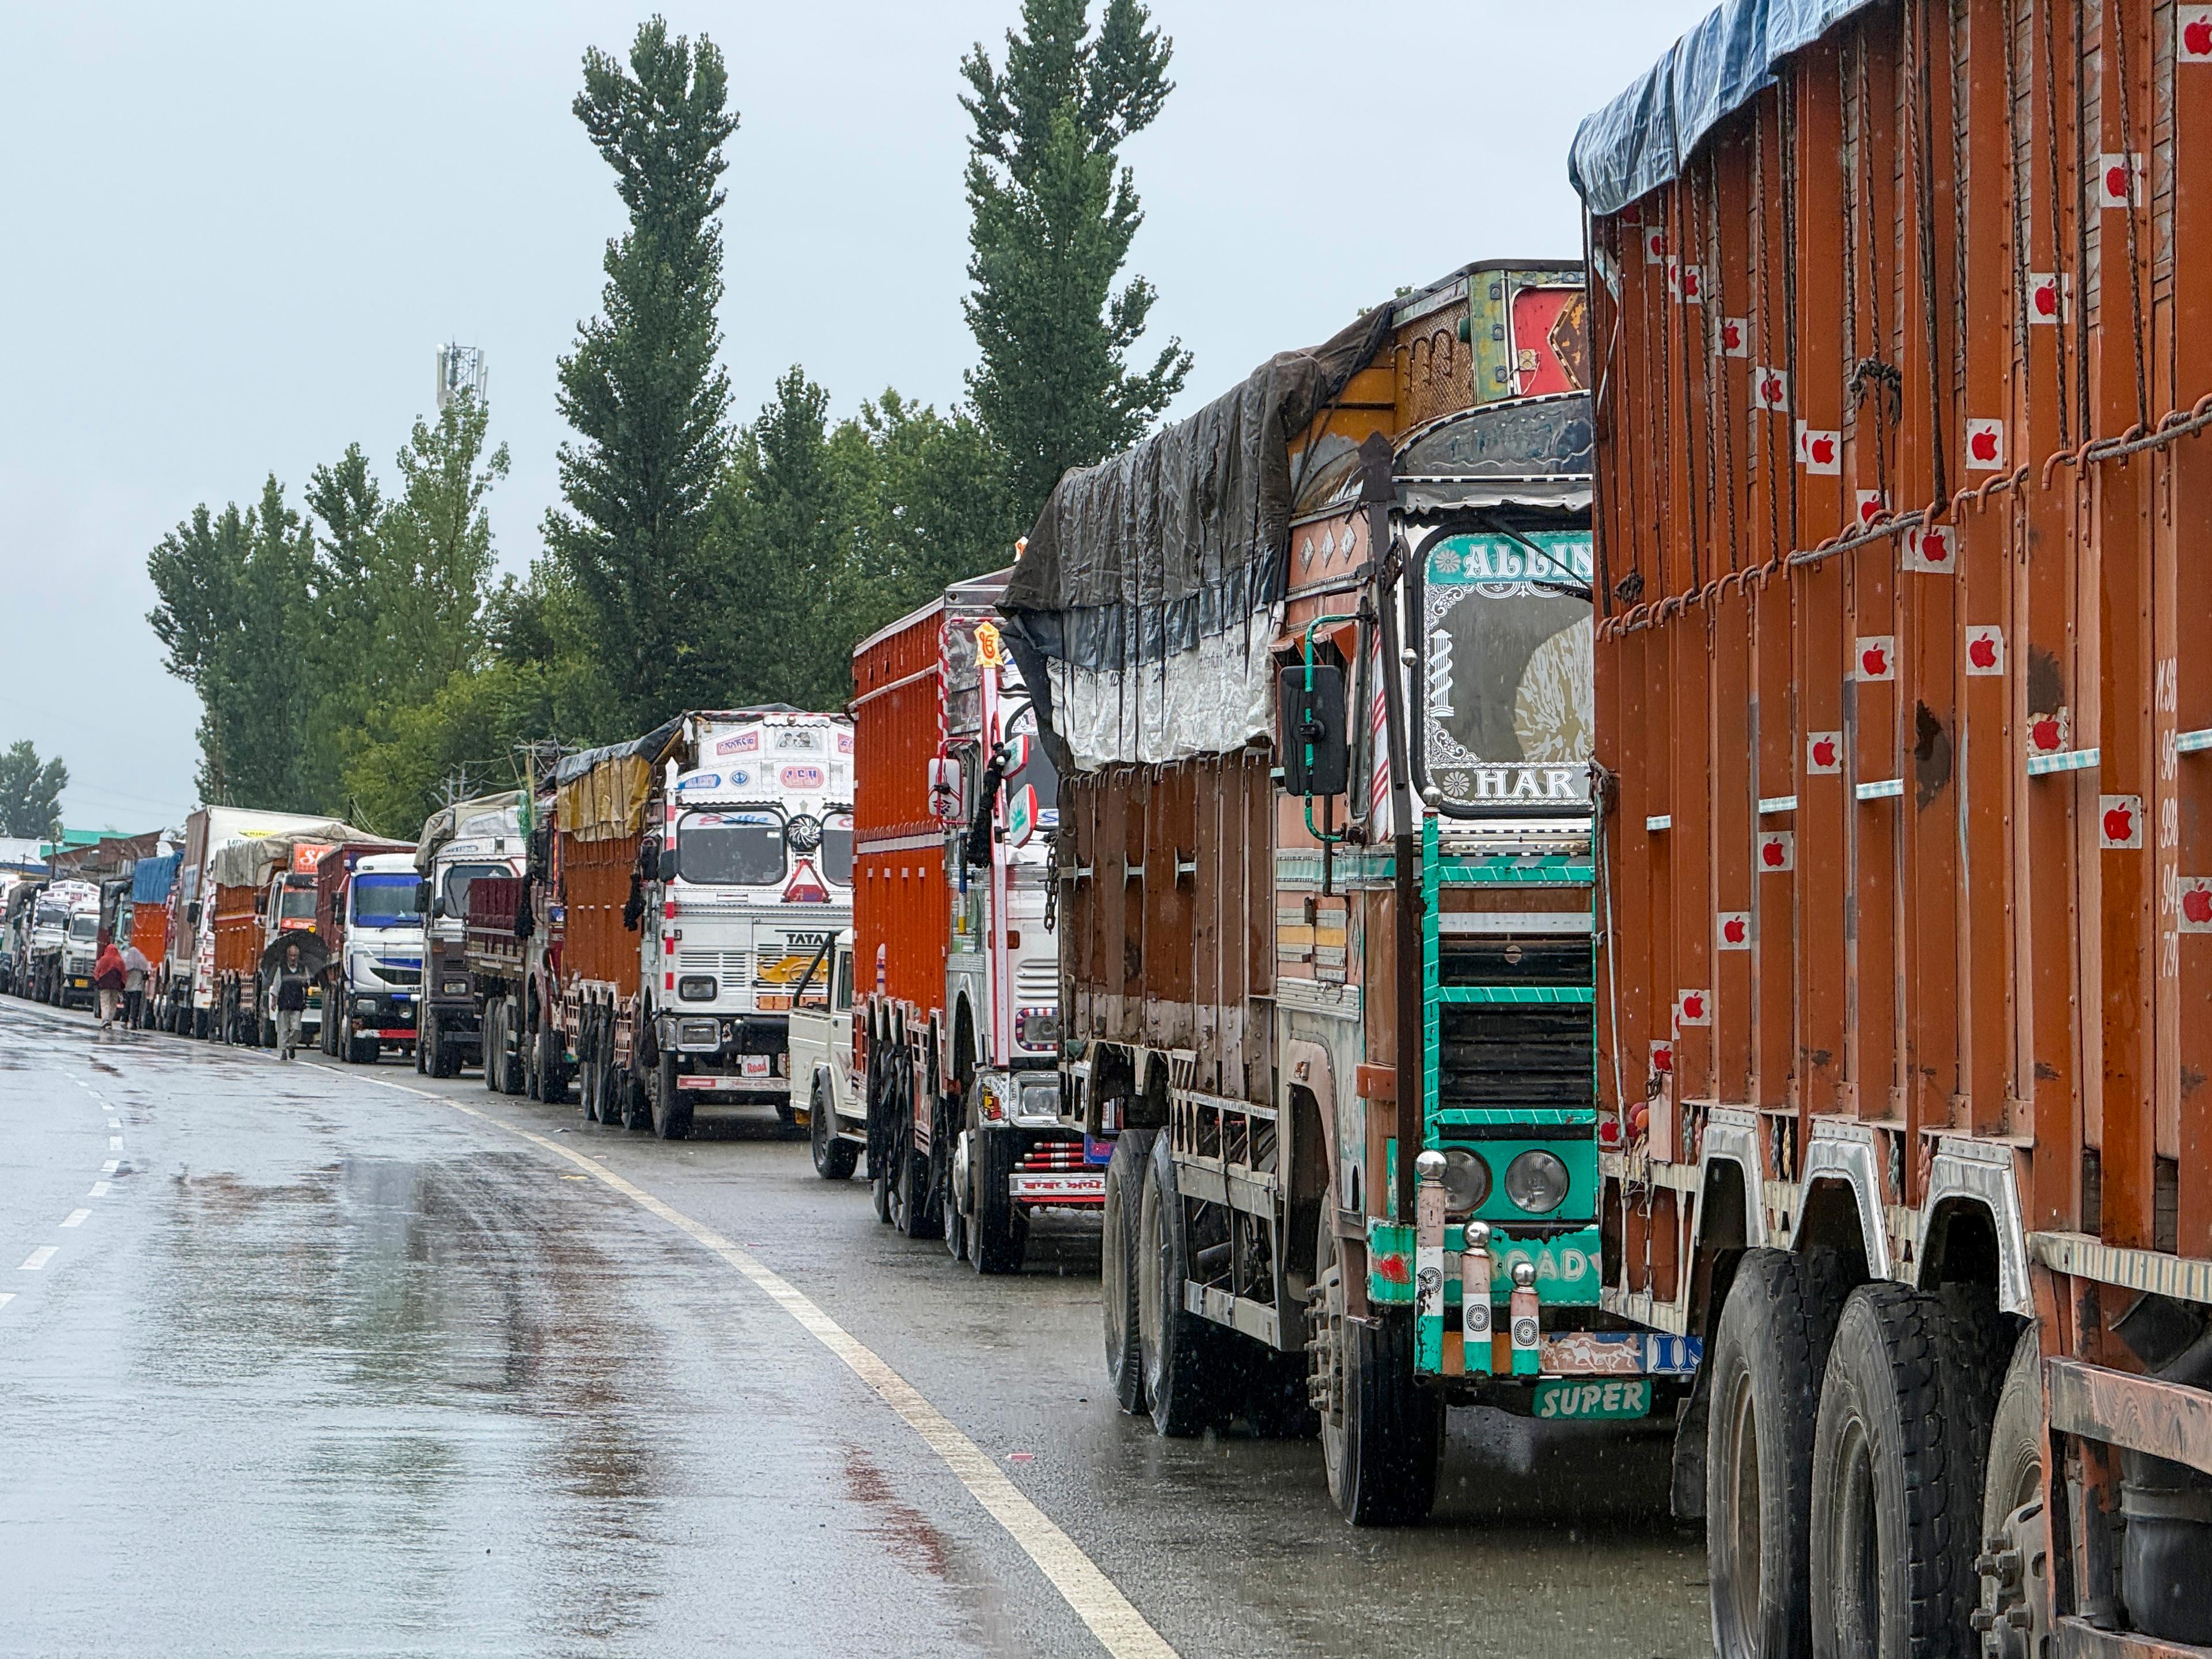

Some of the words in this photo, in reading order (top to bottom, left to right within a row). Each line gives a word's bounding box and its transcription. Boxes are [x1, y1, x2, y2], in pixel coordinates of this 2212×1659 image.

[1474, 769, 1578, 798] HAR
[786, 934, 824, 944] TATA
[1541, 1381, 1644, 1417] SUPER
